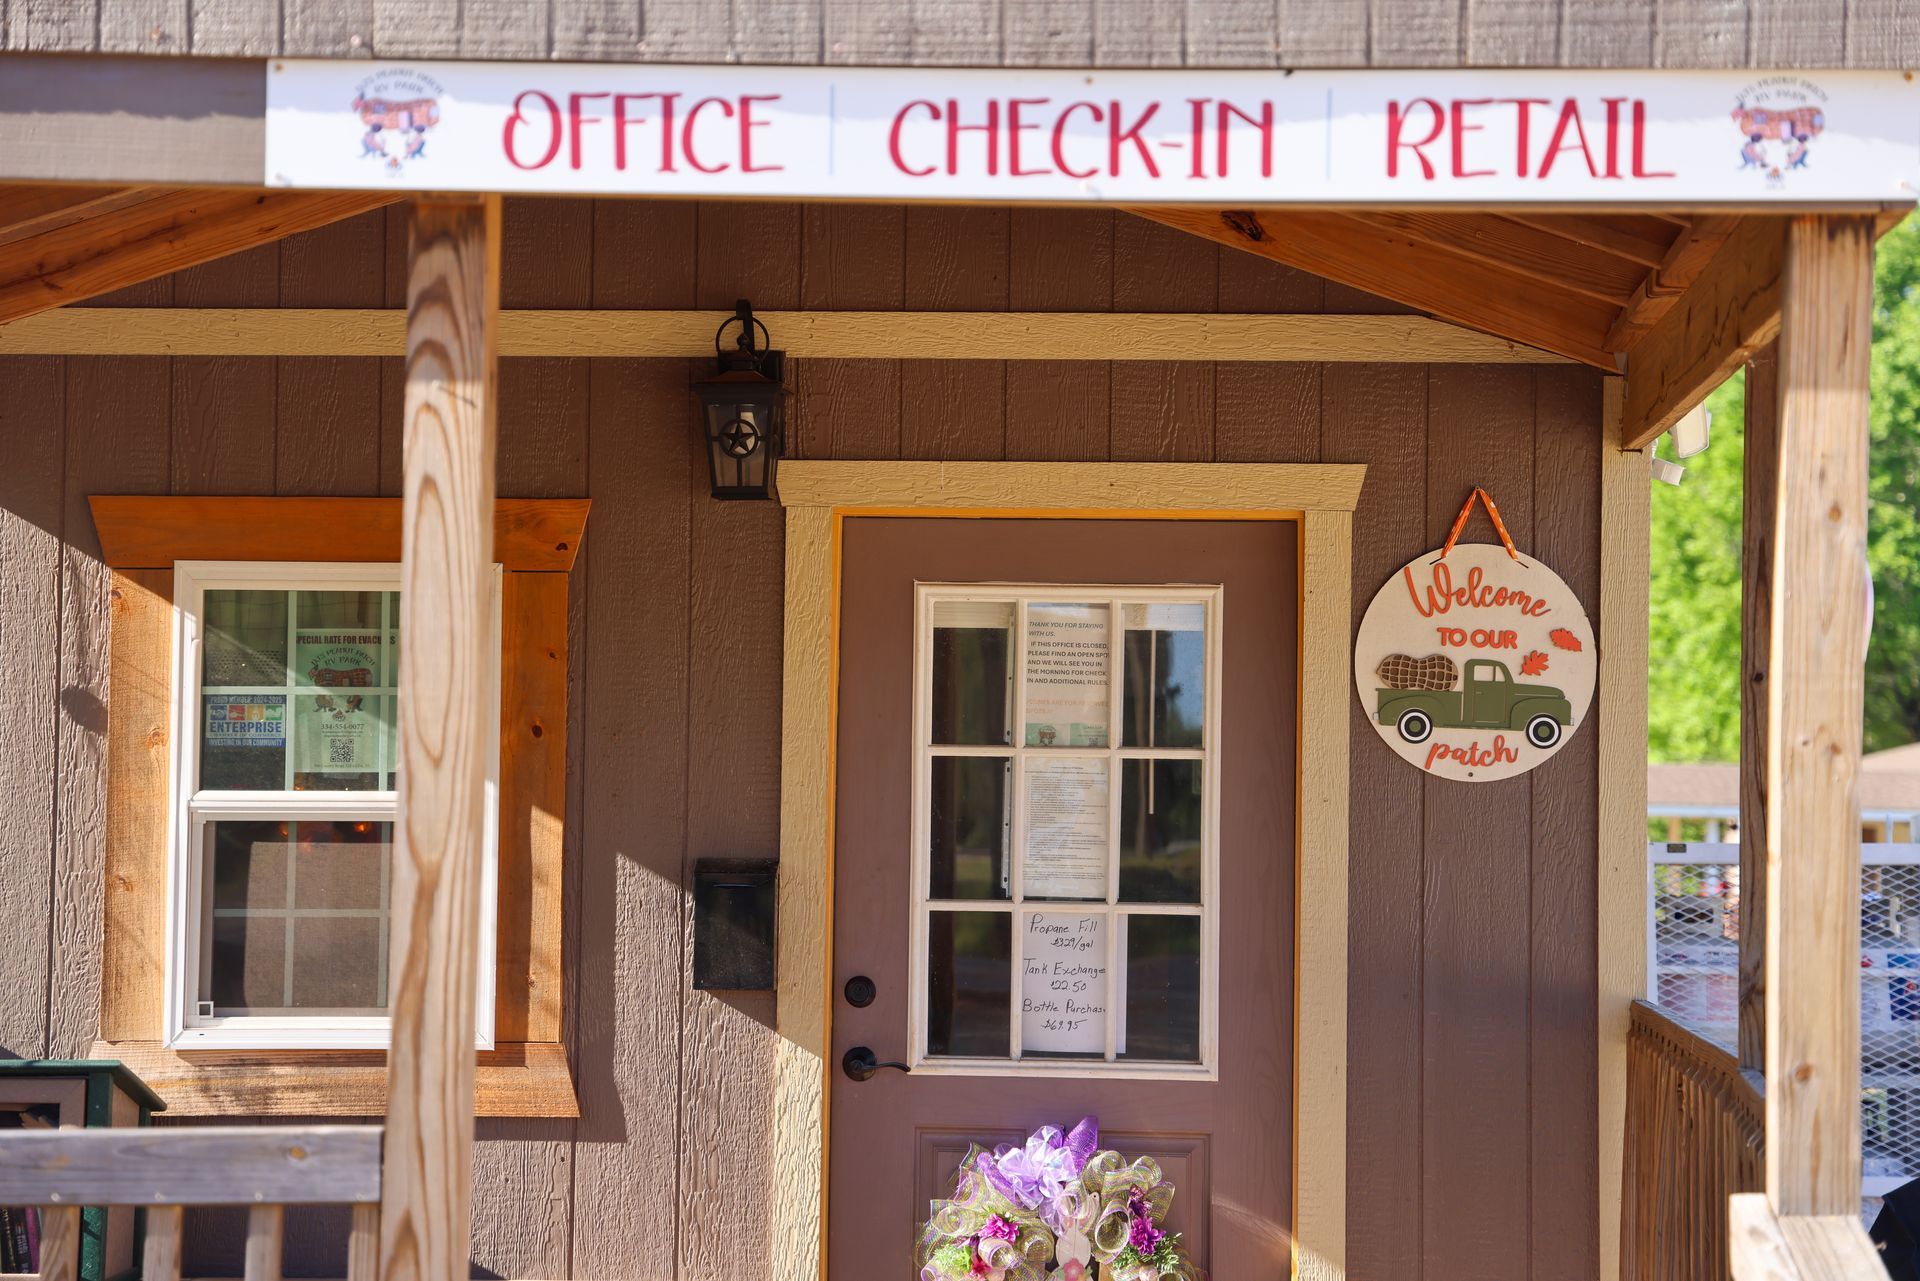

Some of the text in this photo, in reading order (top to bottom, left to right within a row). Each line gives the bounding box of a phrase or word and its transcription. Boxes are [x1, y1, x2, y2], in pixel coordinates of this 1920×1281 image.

[503, 89, 1677, 180] OFFICE CHECK-IN RETAIL
[1404, 562, 1551, 617] Welcome
[324, 635, 341, 645] RATE
[342, 635, 357, 645] FOR
[1437, 627, 1517, 649] TO OUR
[209, 721, 282, 733] ENTERPRISE
[252, 738, 283, 746] COMMUNITY
[1425, 735, 1518, 770] patch
[1030, 913, 1098, 934] Propane Fill
[1023, 958, 1106, 979] Tank Exchange
[1050, 980, 1087, 993] $22.50
[1022, 998, 1060, 1012] Bottle
